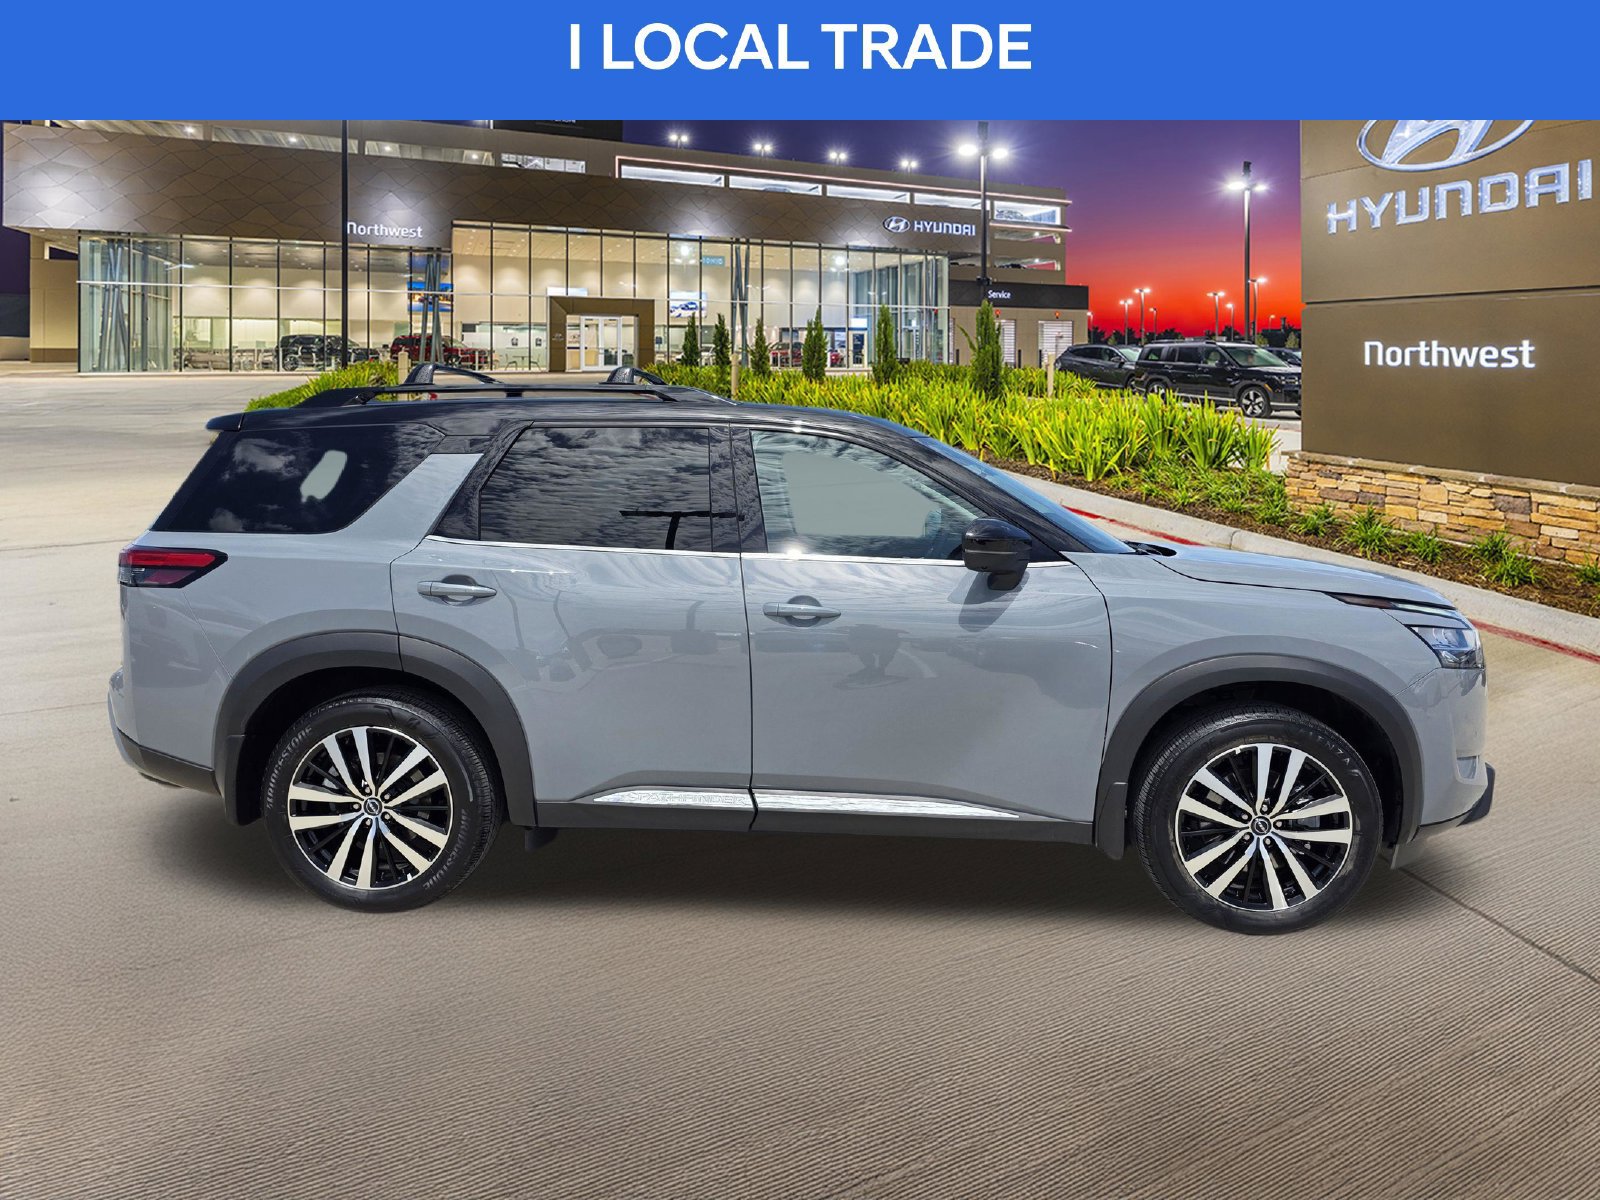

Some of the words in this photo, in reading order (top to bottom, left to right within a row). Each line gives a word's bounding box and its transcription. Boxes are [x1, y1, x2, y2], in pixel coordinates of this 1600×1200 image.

[1326, 159, 1593, 234] HYUNDAI
[346, 221, 423, 238] Northwest
[914, 220, 976, 236] HYUNDAI
[987, 289, 1012, 299] Service
[1363, 339, 1536, 369] Northwest
